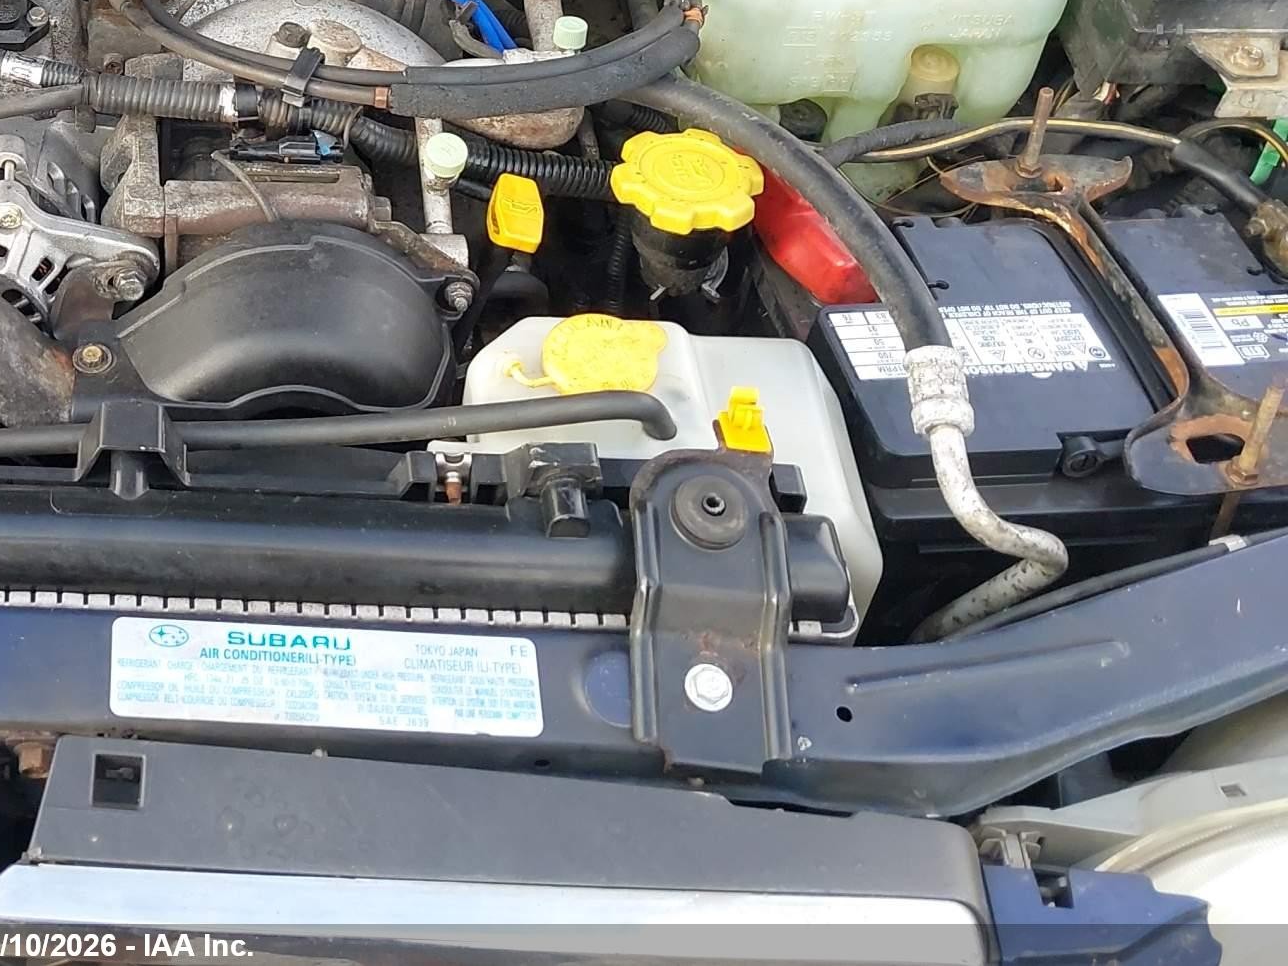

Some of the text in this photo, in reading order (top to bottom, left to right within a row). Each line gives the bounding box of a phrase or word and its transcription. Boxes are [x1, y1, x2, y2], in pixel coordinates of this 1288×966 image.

[227, 630, 352, 651] SUBARU
[199, 647, 220, 660] AIR
[415, 643, 478, 658] TOKYO JAPAN
[403, 657, 474, 675] CLIMATISEUR
